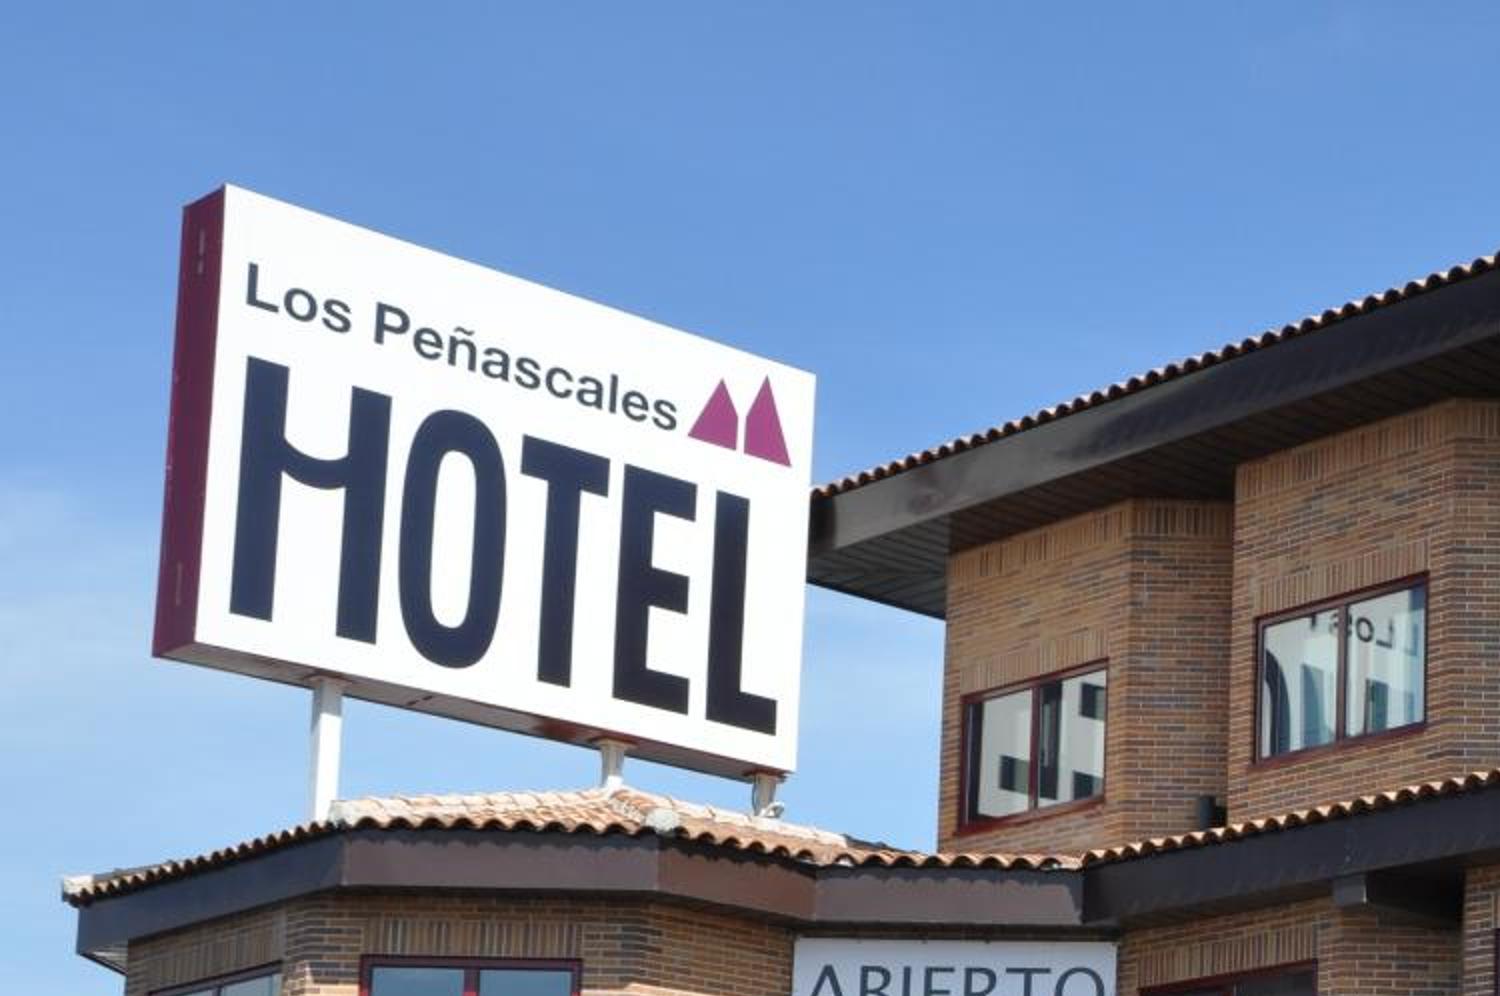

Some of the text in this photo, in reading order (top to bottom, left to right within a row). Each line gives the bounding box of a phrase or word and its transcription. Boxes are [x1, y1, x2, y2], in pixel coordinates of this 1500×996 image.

[246, 262, 677, 431] Los Peñascales
[229, 356, 776, 736] HOTEL
